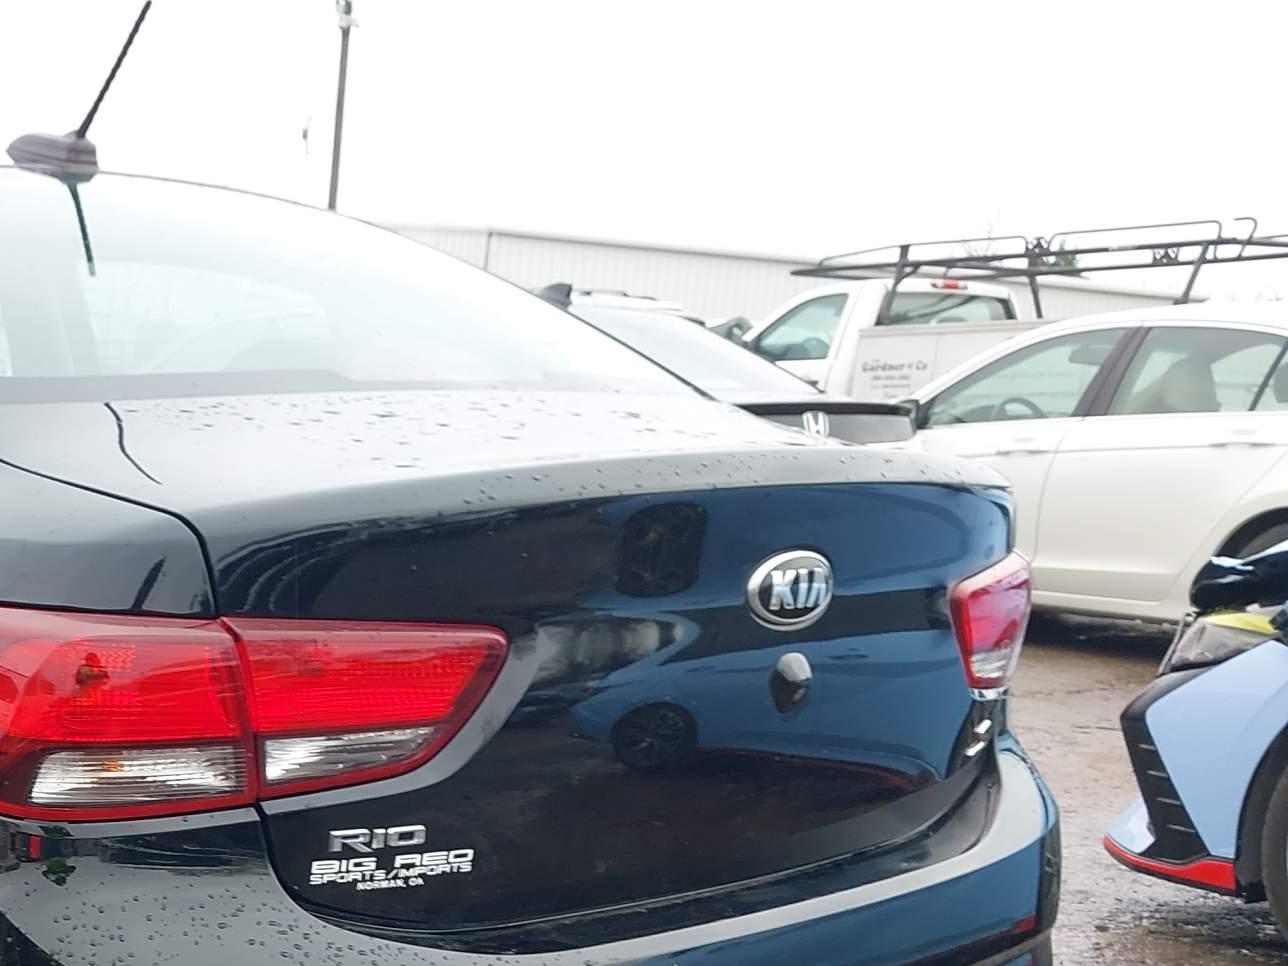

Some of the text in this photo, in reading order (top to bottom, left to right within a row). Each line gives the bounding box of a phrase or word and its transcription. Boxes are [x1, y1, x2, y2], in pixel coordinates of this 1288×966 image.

[769, 567, 827, 610] KIA
[328, 824, 427, 853] RIO
[310, 849, 475, 874] BIG RED
